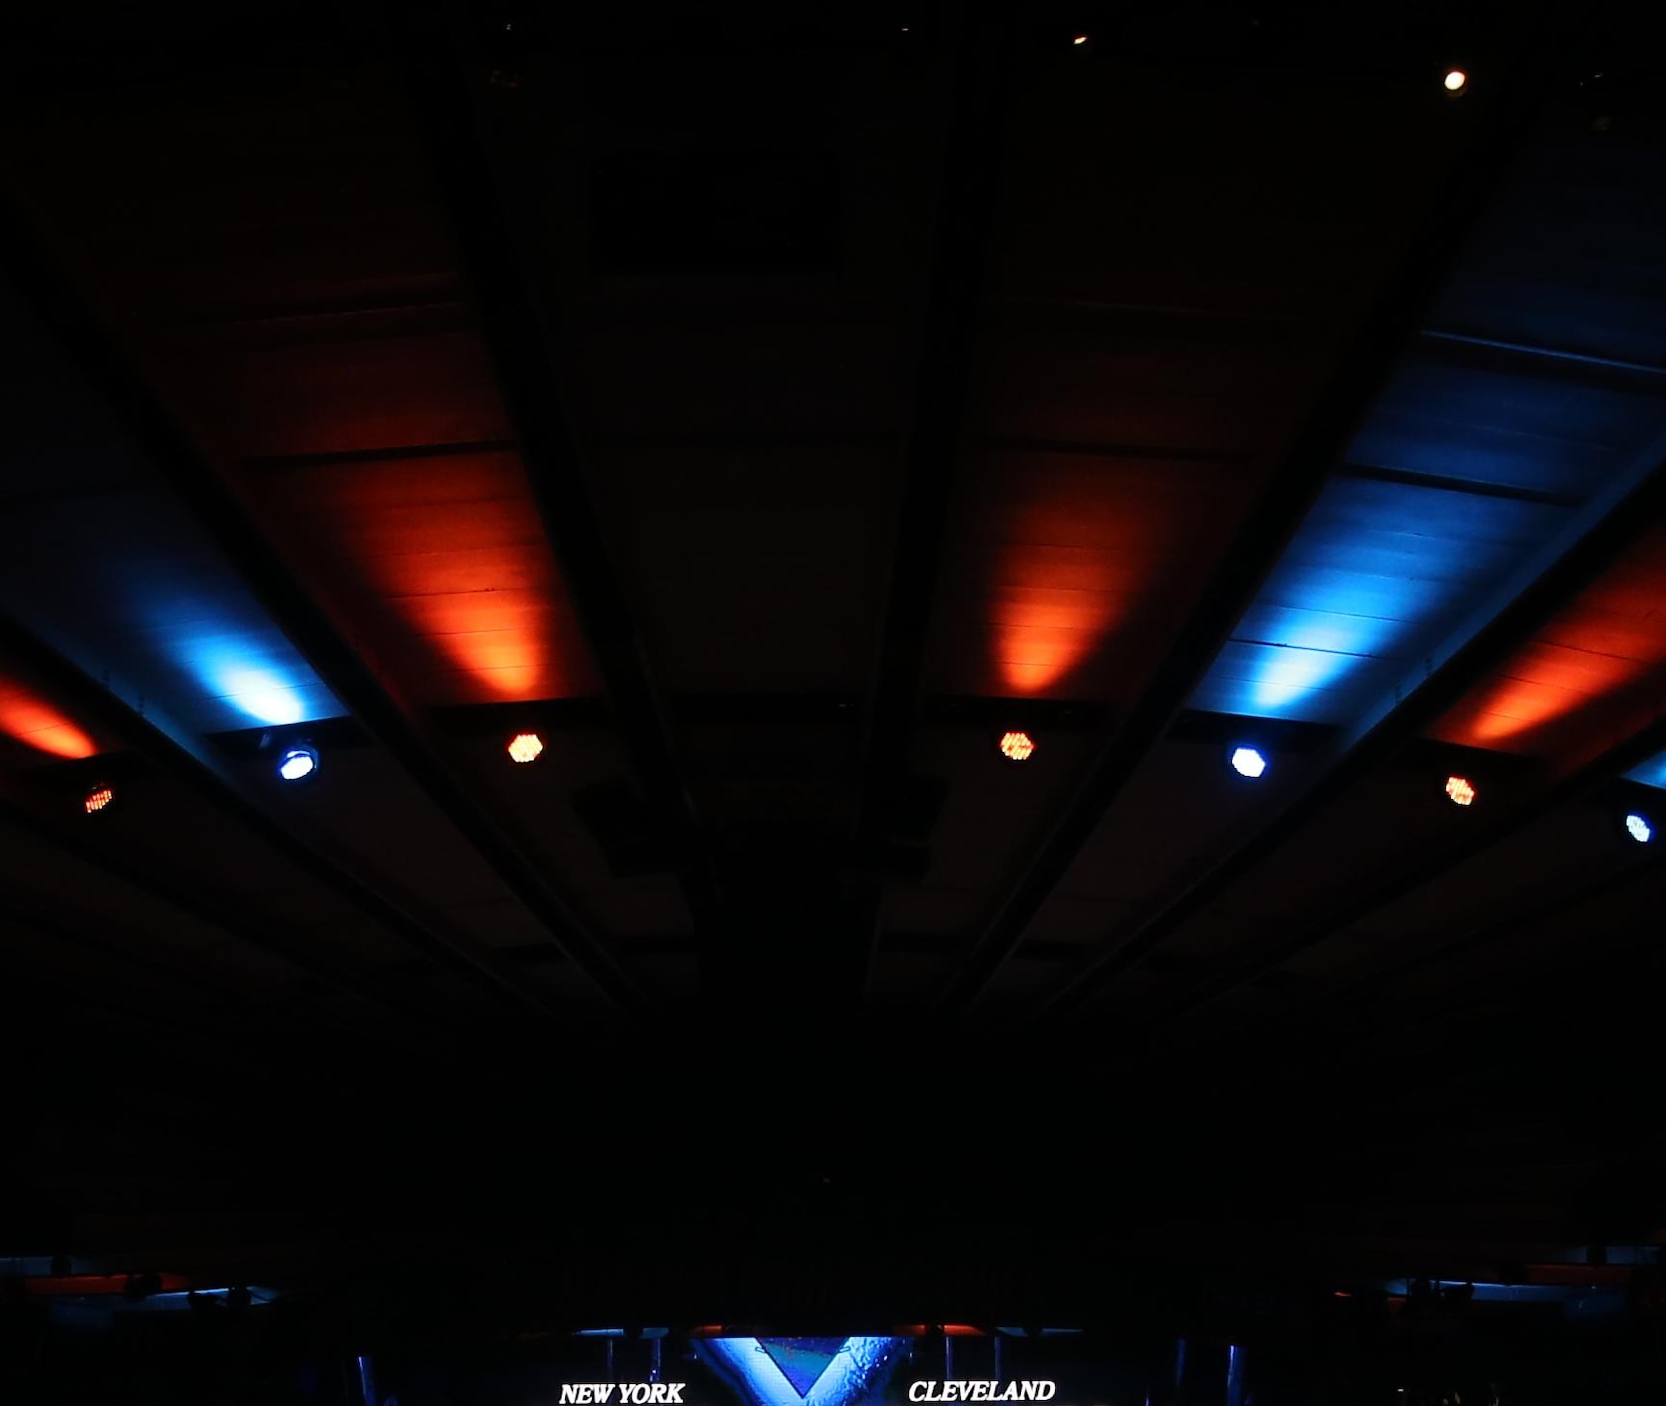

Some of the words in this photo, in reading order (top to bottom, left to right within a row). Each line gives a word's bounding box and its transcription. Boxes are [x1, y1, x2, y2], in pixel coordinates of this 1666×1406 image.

[559, 1383, 615, 1404] NEW
[617, 1383, 686, 1404] YORK
[908, 1380, 1056, 1402] CLEVELAND
